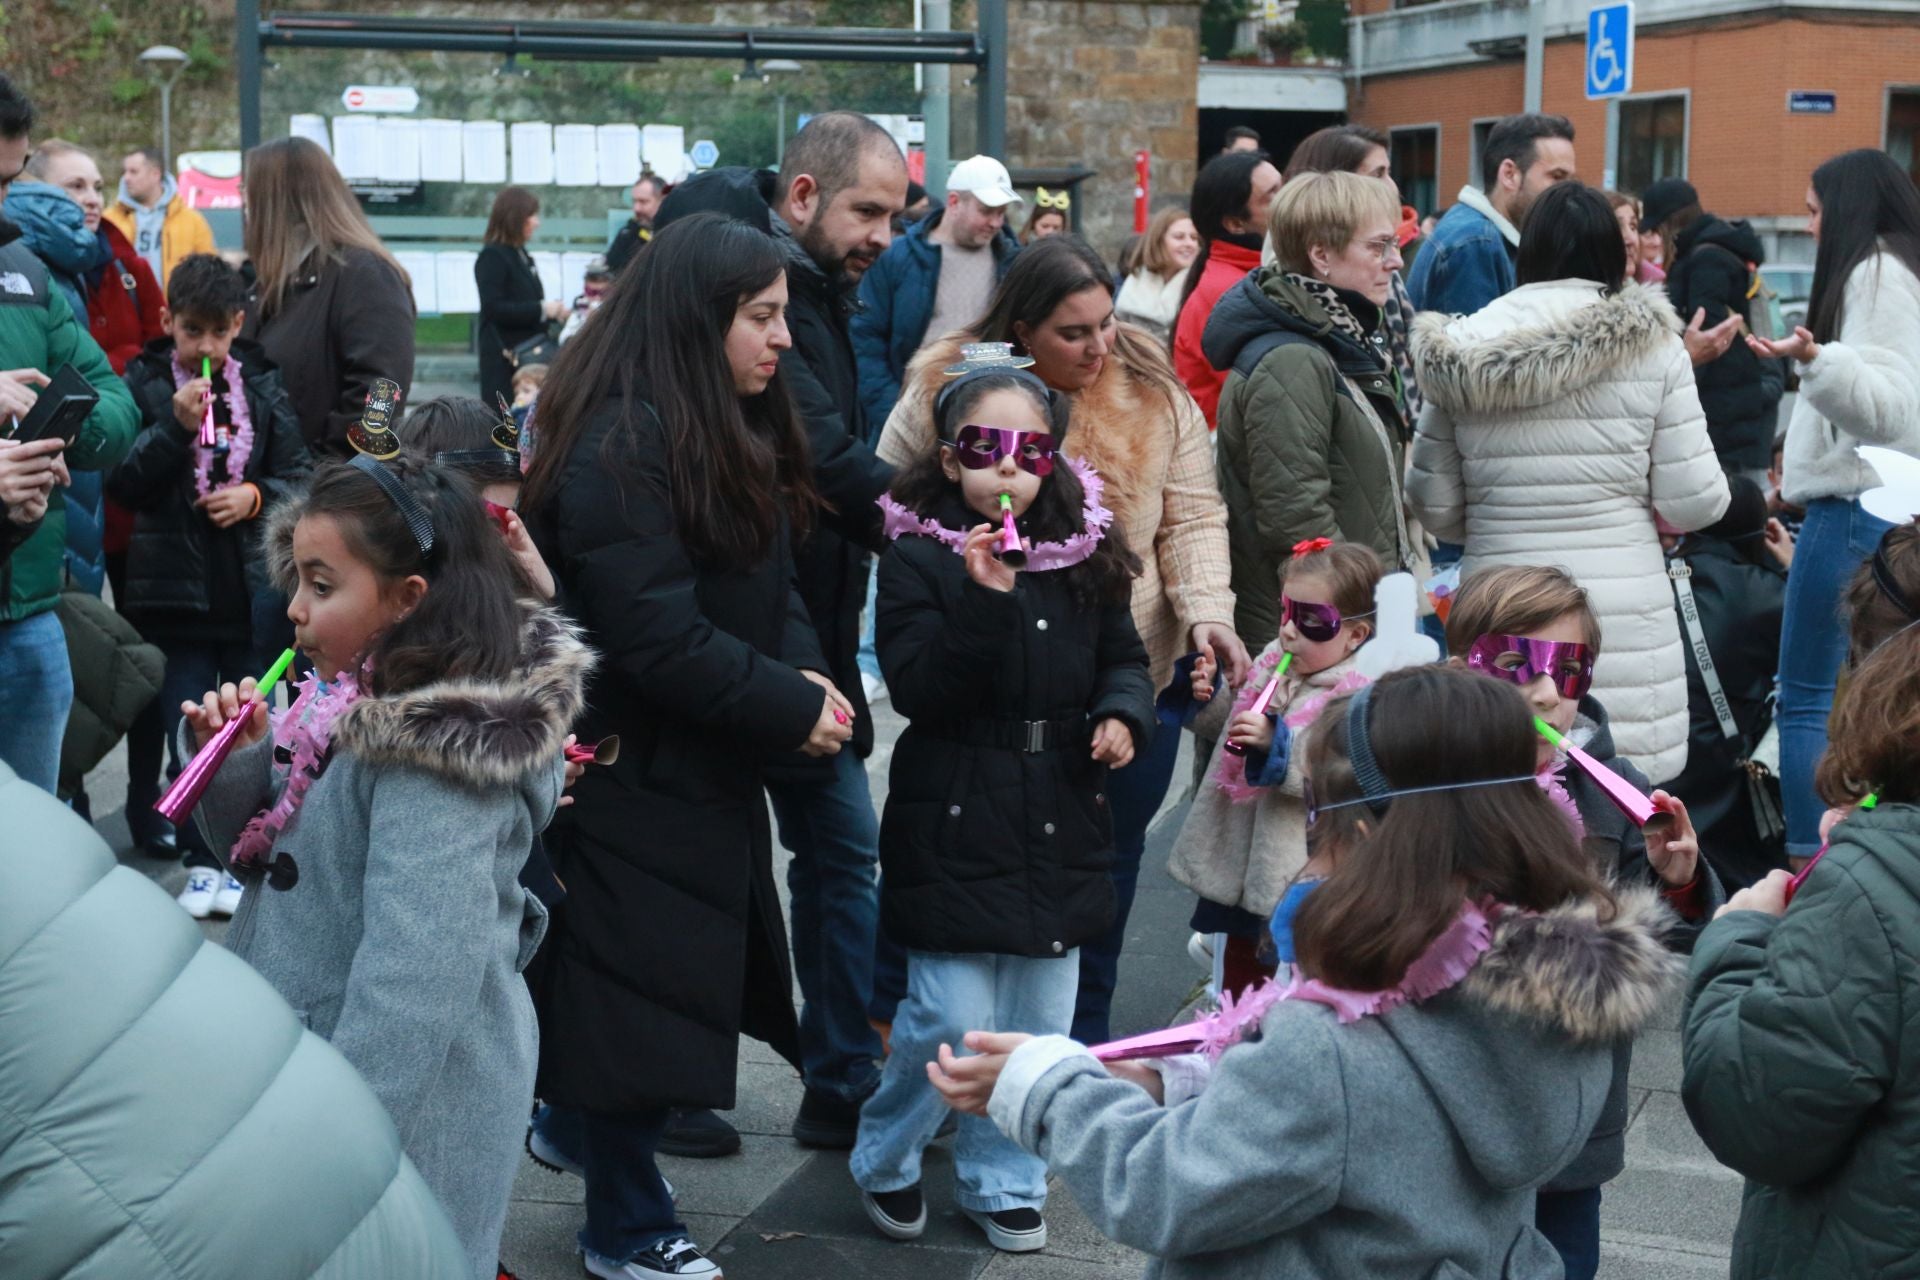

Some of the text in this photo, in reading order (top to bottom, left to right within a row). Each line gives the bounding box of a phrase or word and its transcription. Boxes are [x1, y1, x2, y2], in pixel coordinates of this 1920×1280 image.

[1680, 592, 1697, 623] TOUS
[1694, 638, 1712, 673] TOUS
[1711, 688, 1730, 722] TOUS
